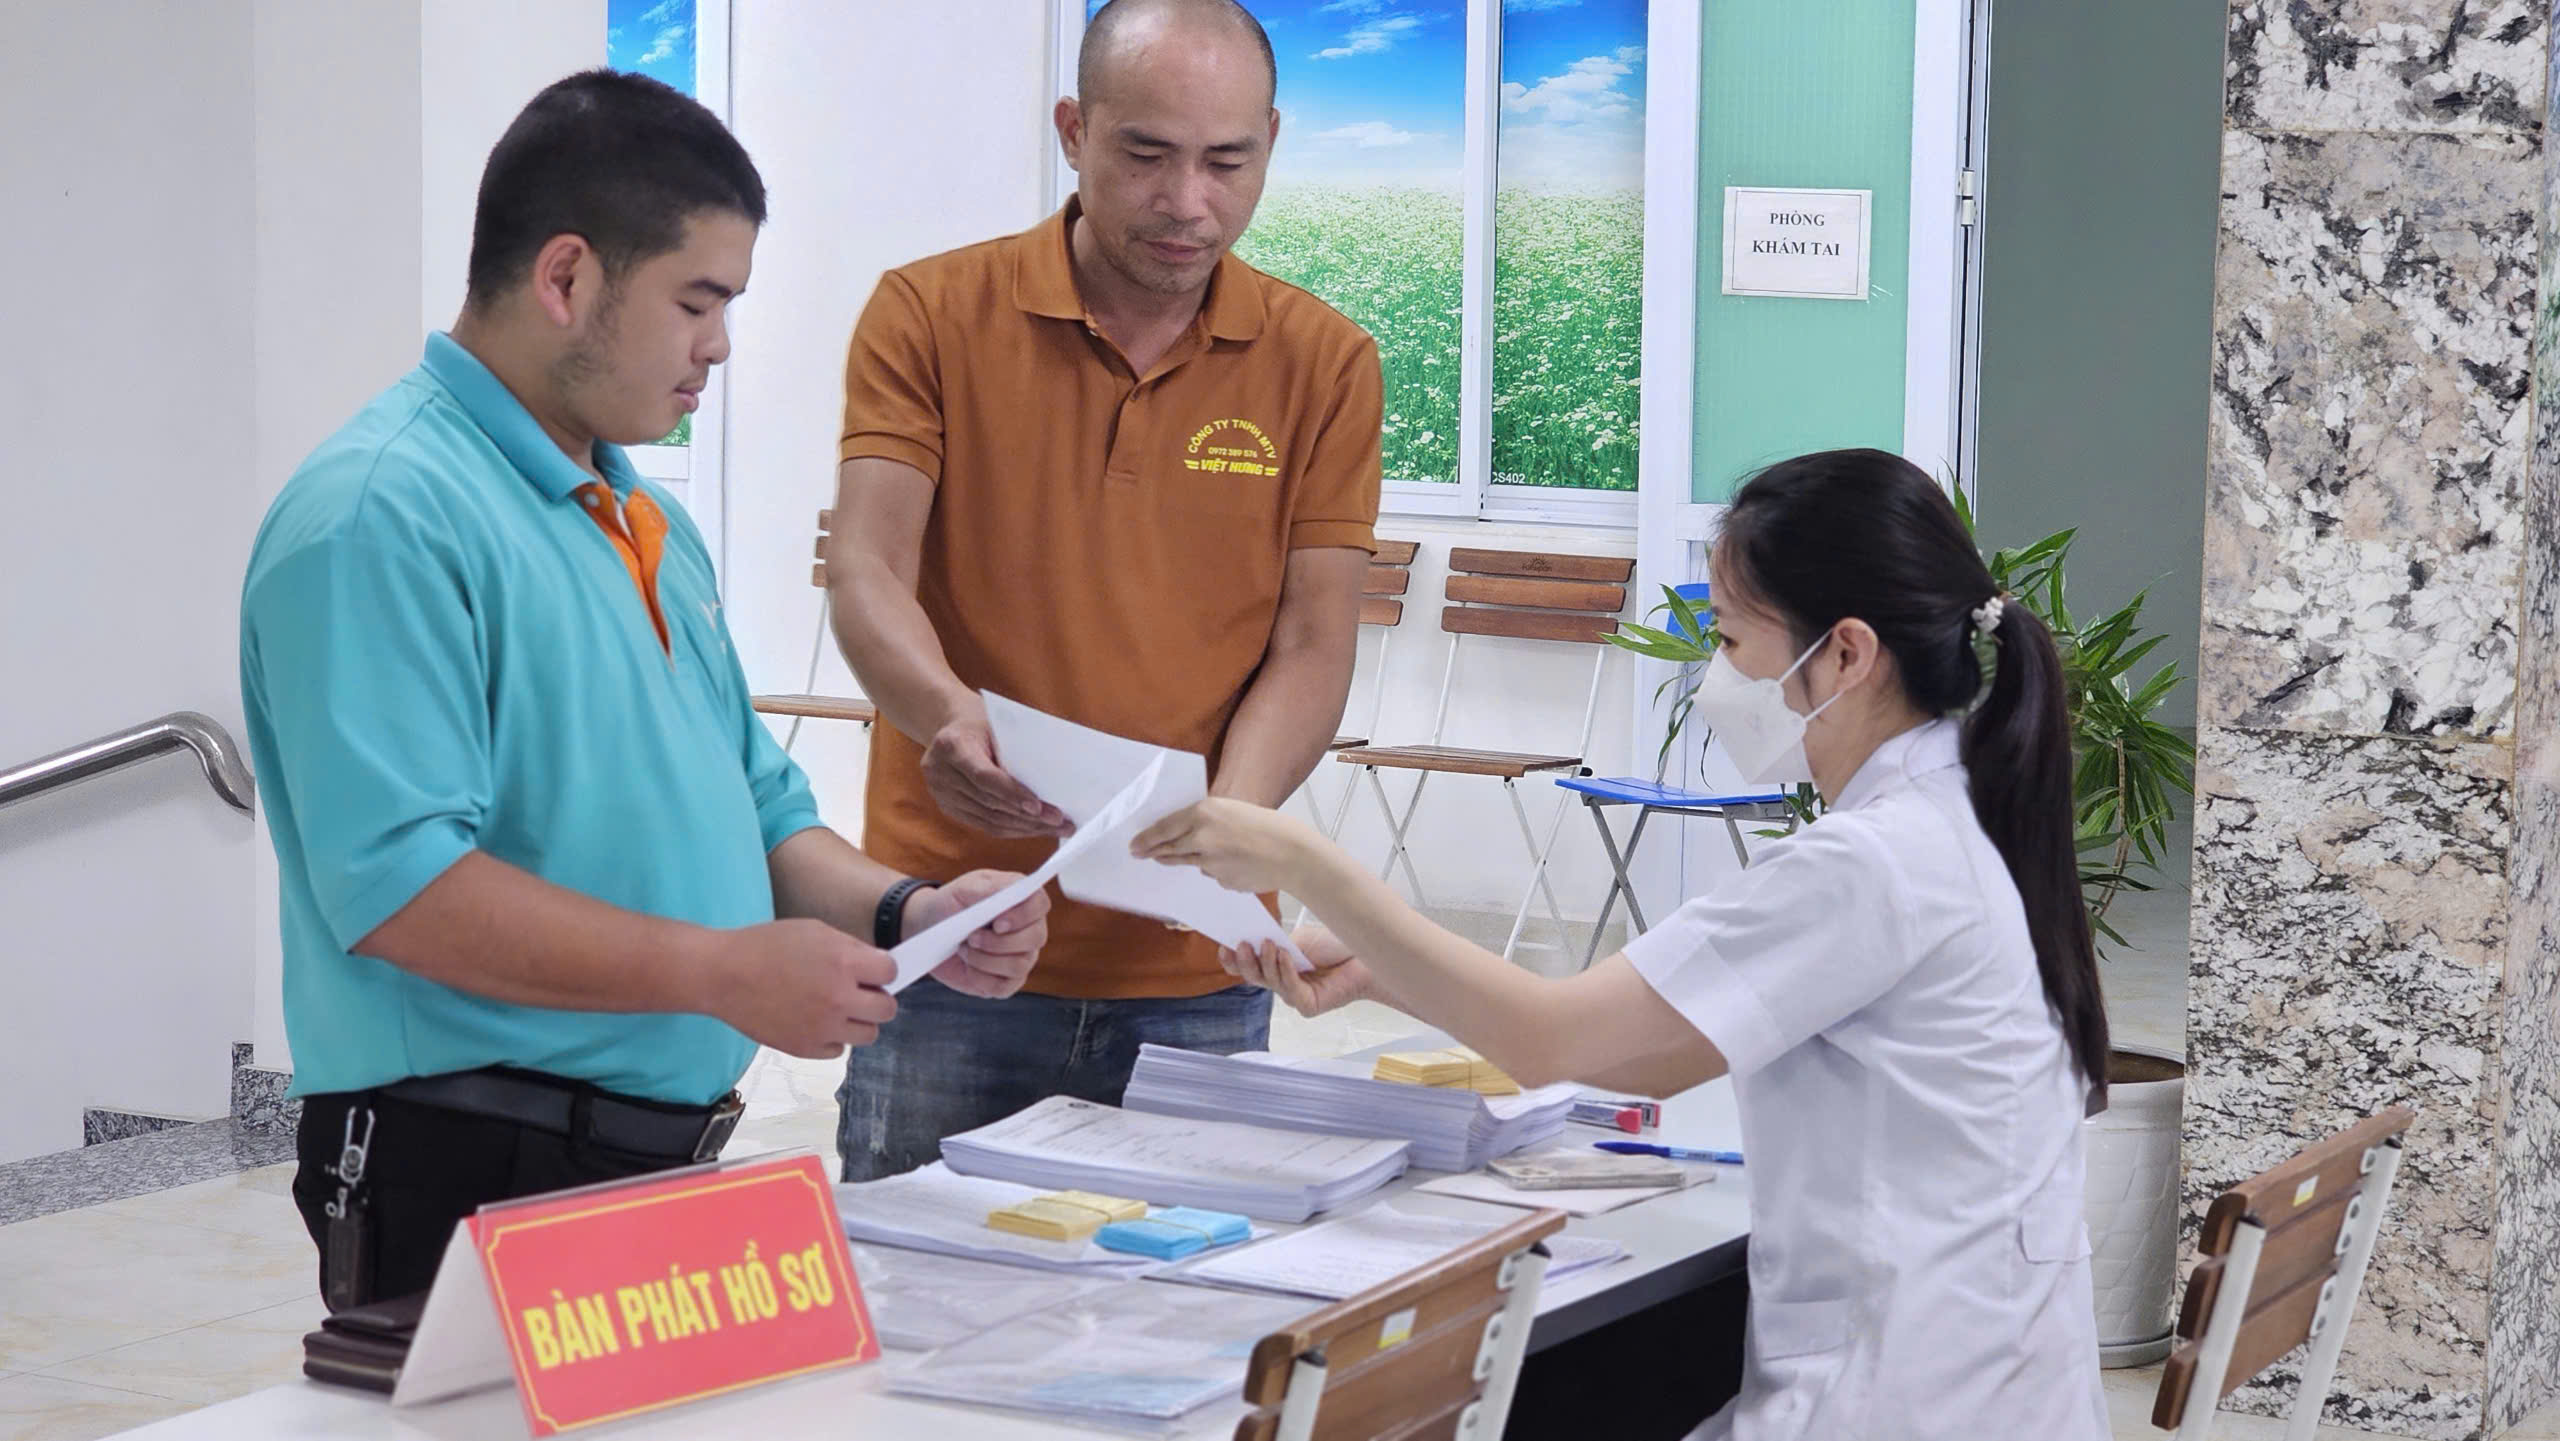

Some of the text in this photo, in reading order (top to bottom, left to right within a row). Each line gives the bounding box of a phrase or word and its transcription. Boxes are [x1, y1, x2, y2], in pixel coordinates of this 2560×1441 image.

[1769, 210, 1825, 227] PHÒNG
[1752, 237, 1840, 256] KHÁM TAI
[1213, 419, 1229, 430] TY
[1231, 419, 1262, 438] TNHH
[1259, 436, 1277, 458] MTV
[1200, 458, 1228, 473] VIỆT
[522, 1240, 834, 1371] BÀN PHÁT HỒ SƠ
